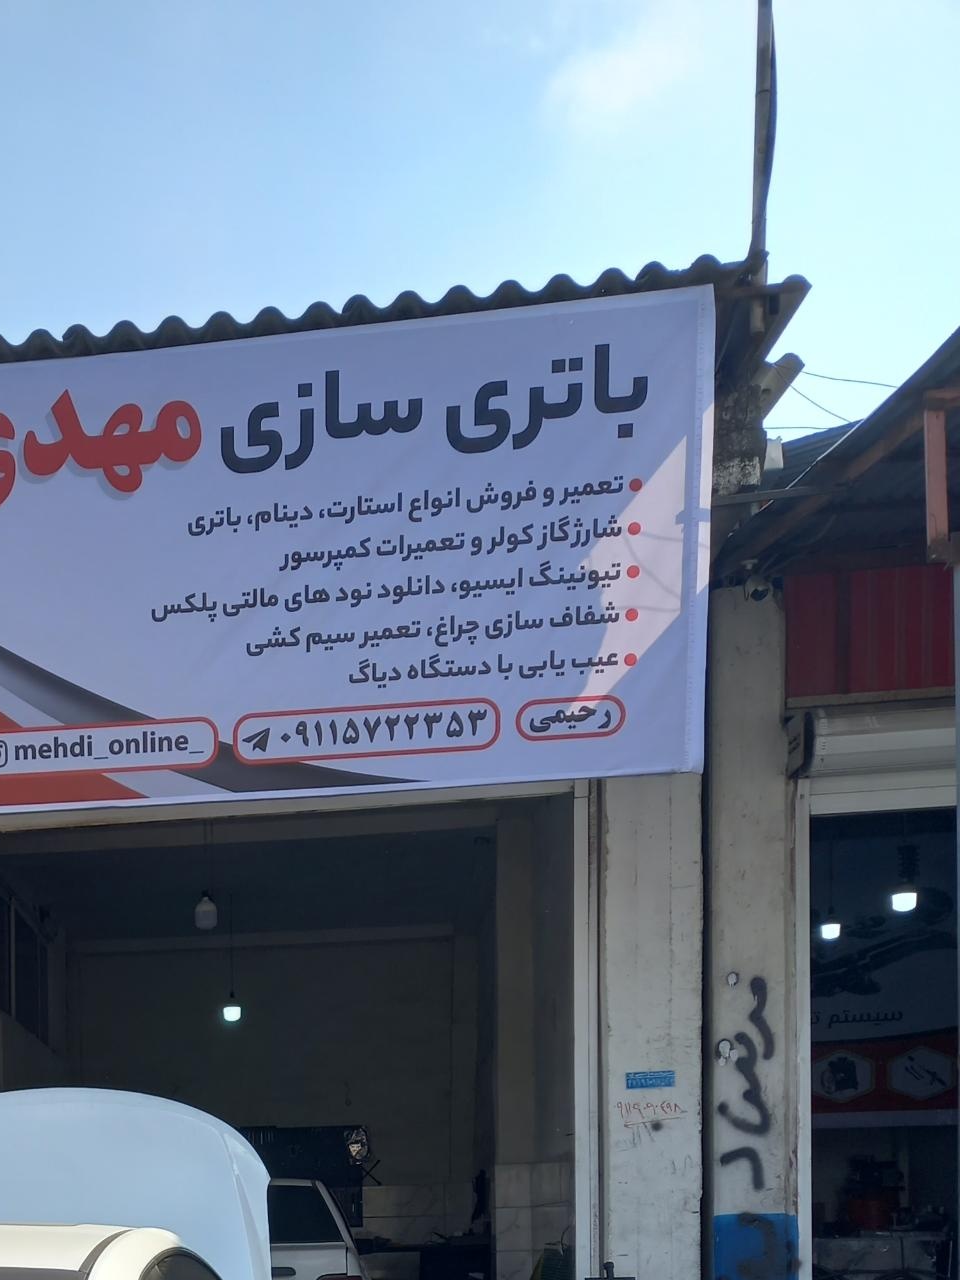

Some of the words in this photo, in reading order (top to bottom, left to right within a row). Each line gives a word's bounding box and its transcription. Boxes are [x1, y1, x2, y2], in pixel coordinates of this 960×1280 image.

[445, 343, 648, 454] باتری
[220, 369, 423, 474] سازی
[408, 487, 460, 522] انواع
[466, 480, 537, 513] فروش
[543, 491, 555, 507] و
[559, 475, 624, 505] تعمیر
[188, 507, 241, 536] باتری
[247, 502, 313, 531] دینام،
[319, 492, 403, 524] استارت،
[376, 532, 465, 562] تعمیرات
[470, 536, 482, 556] و
[487, 523, 534, 554] کولر
[279, 537, 371, 572] کمپرسور
[378, 575, 445, 604] دانلود
[529, 560, 621, 591] تیونینگ
[151, 592, 217, 622] پلکس
[222, 588, 279, 616] مالتی
[284, 584, 330, 612] های
[336, 582, 372, 607] نود
[485, 610, 543, 639] سازی
[549, 601, 619, 628] شفاف
[246, 626, 300, 656] کشی
[306, 629, 355, 652] سیم
[359, 620, 421, 648] تعمیر
[349, 658, 402, 688] دیاگ
[408, 653, 491, 680] دستگاه
[497, 654, 513, 680] با
[519, 650, 565, 679] یابی
[572, 652, 618, 675] عیب
[280, 708, 488, 747] ۰۹۱۱۵۷۲۲۳۵۳
[529, 703, 612, 732] رحیمی
[14, 731, 205, 760] mehdi_online_
[828, 1010, 904, 1029] سیستم
